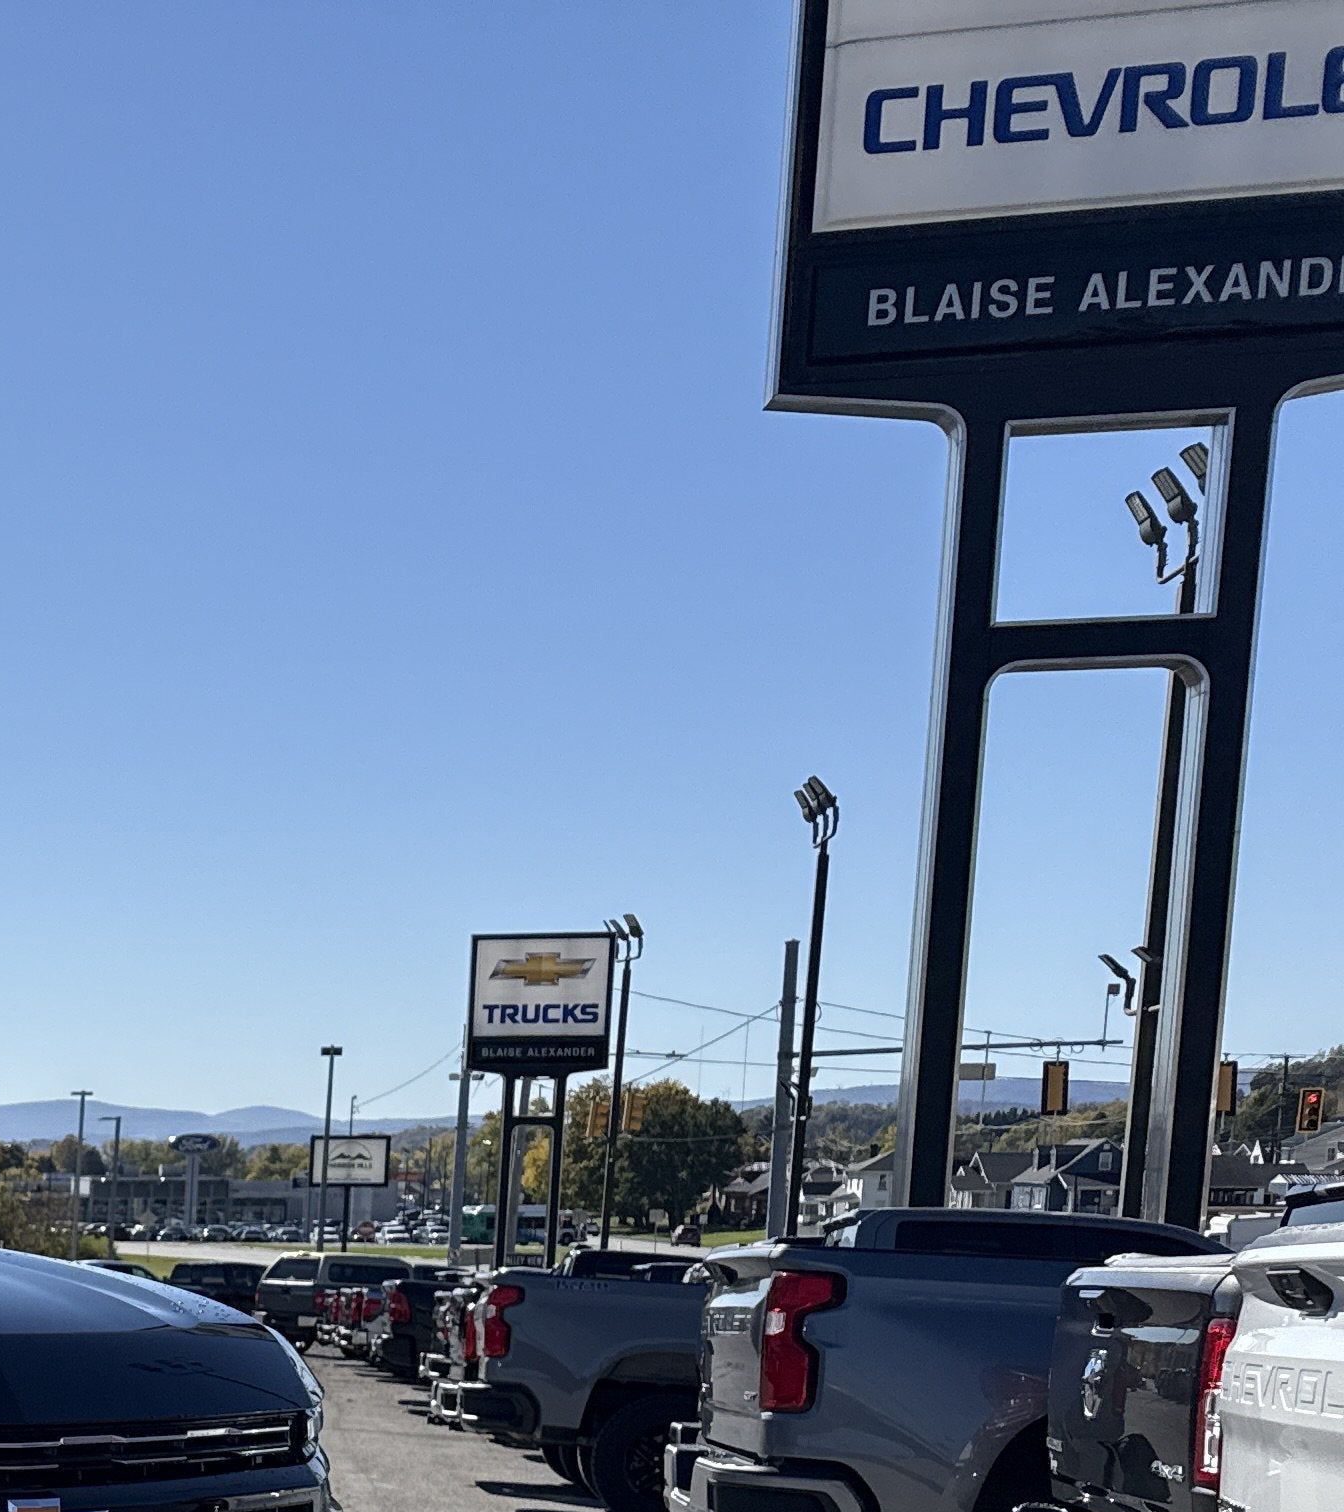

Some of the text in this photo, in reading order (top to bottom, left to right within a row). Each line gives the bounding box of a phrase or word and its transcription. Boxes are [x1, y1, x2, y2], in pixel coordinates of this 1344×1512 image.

[867, 256, 1344, 326] BLAISE ALEXAND
[482, 1003, 600, 1024] TRUCKS
[481, 1047, 595, 1057] BLAISE ALEXANDER
